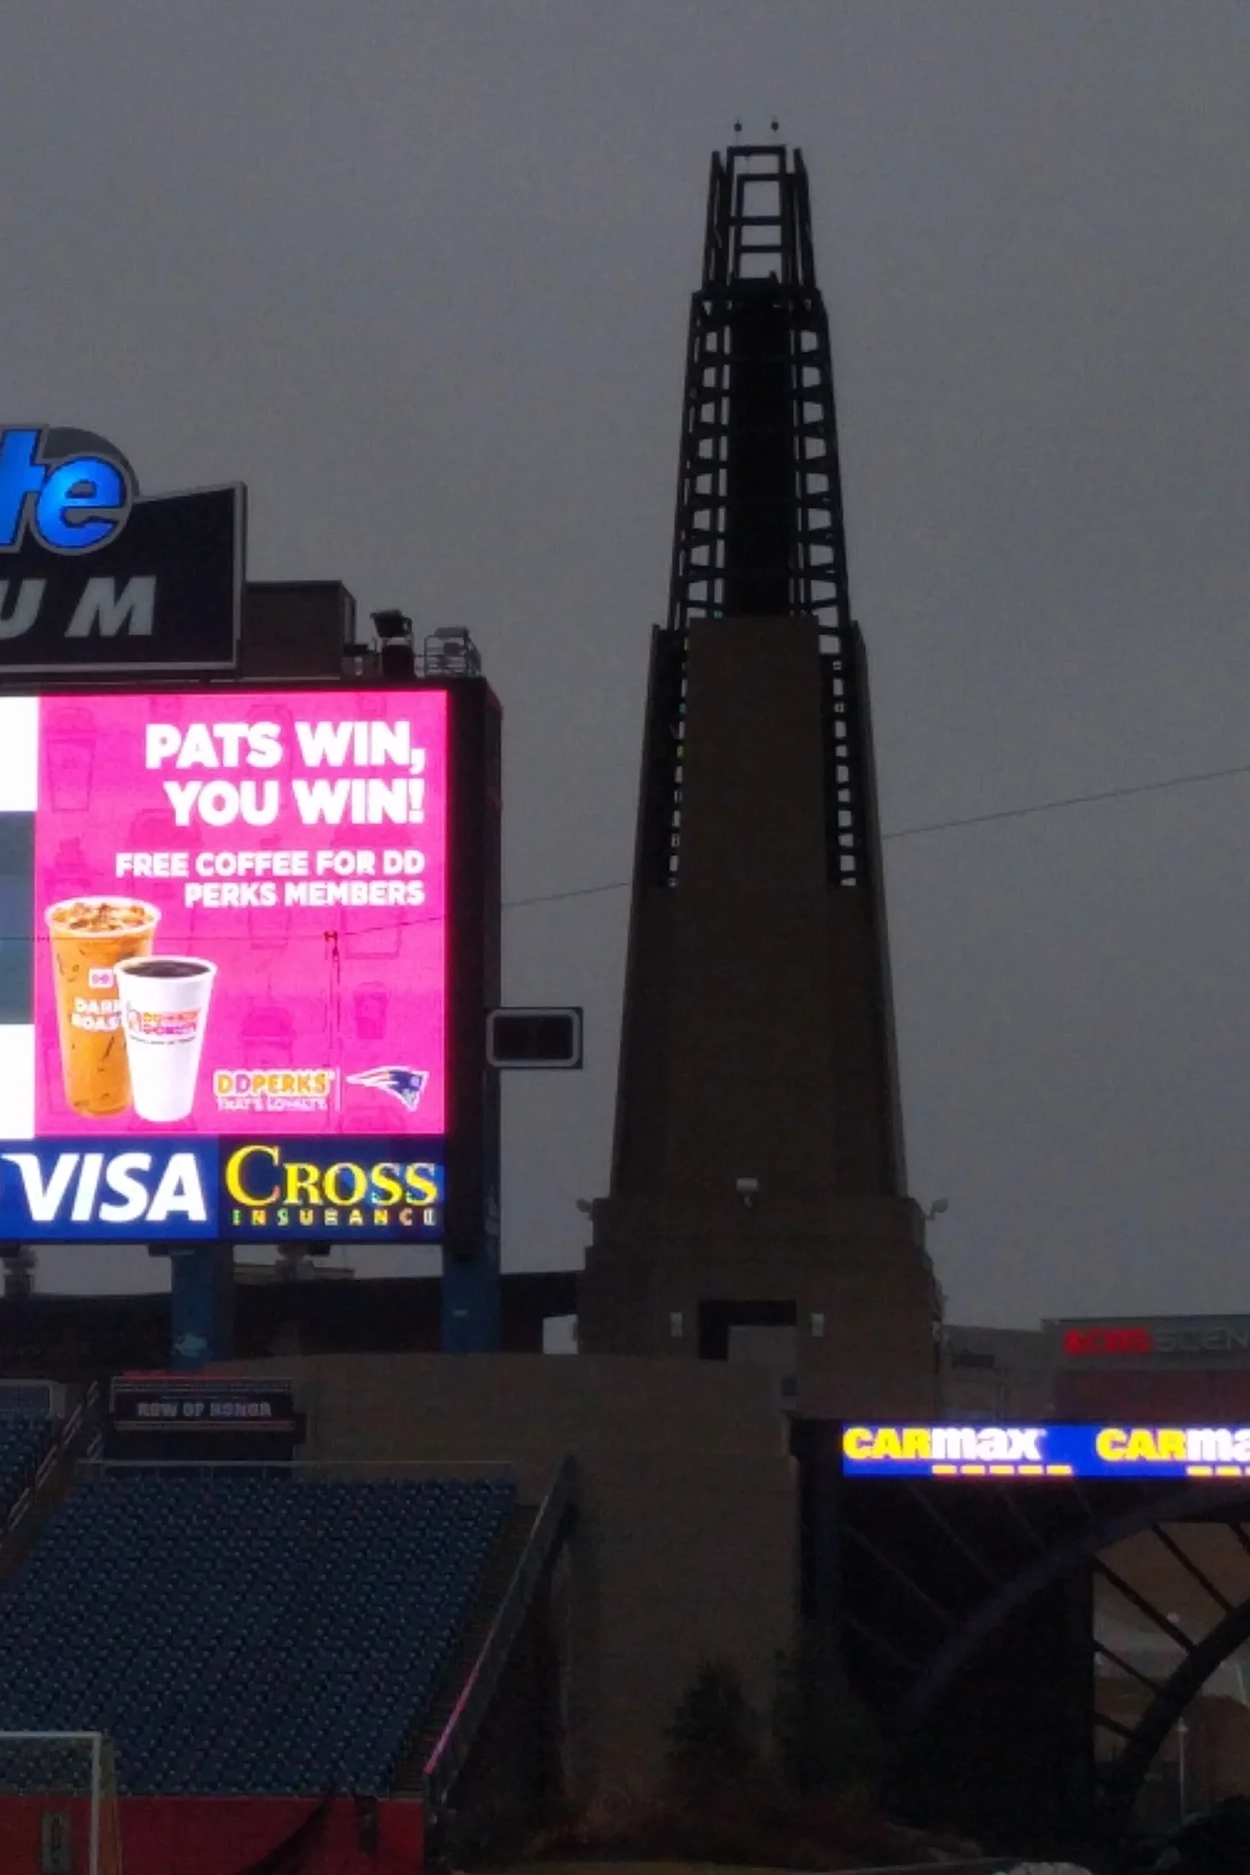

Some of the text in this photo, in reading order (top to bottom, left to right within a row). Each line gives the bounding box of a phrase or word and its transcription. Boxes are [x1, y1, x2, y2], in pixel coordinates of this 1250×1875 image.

[145, 719, 427, 774] PATS WIN,
[163, 778, 426, 827] YOU WIN!
[115, 850, 425, 878] FREE COFFEE FOR DD
[184, 881, 425, 908] PERKS MEMBERS
[0, 1152, 207, 1222] VISA
[225, 1145, 438, 1207] CROSS
[842, 1426, 1043, 1461] CARmax
